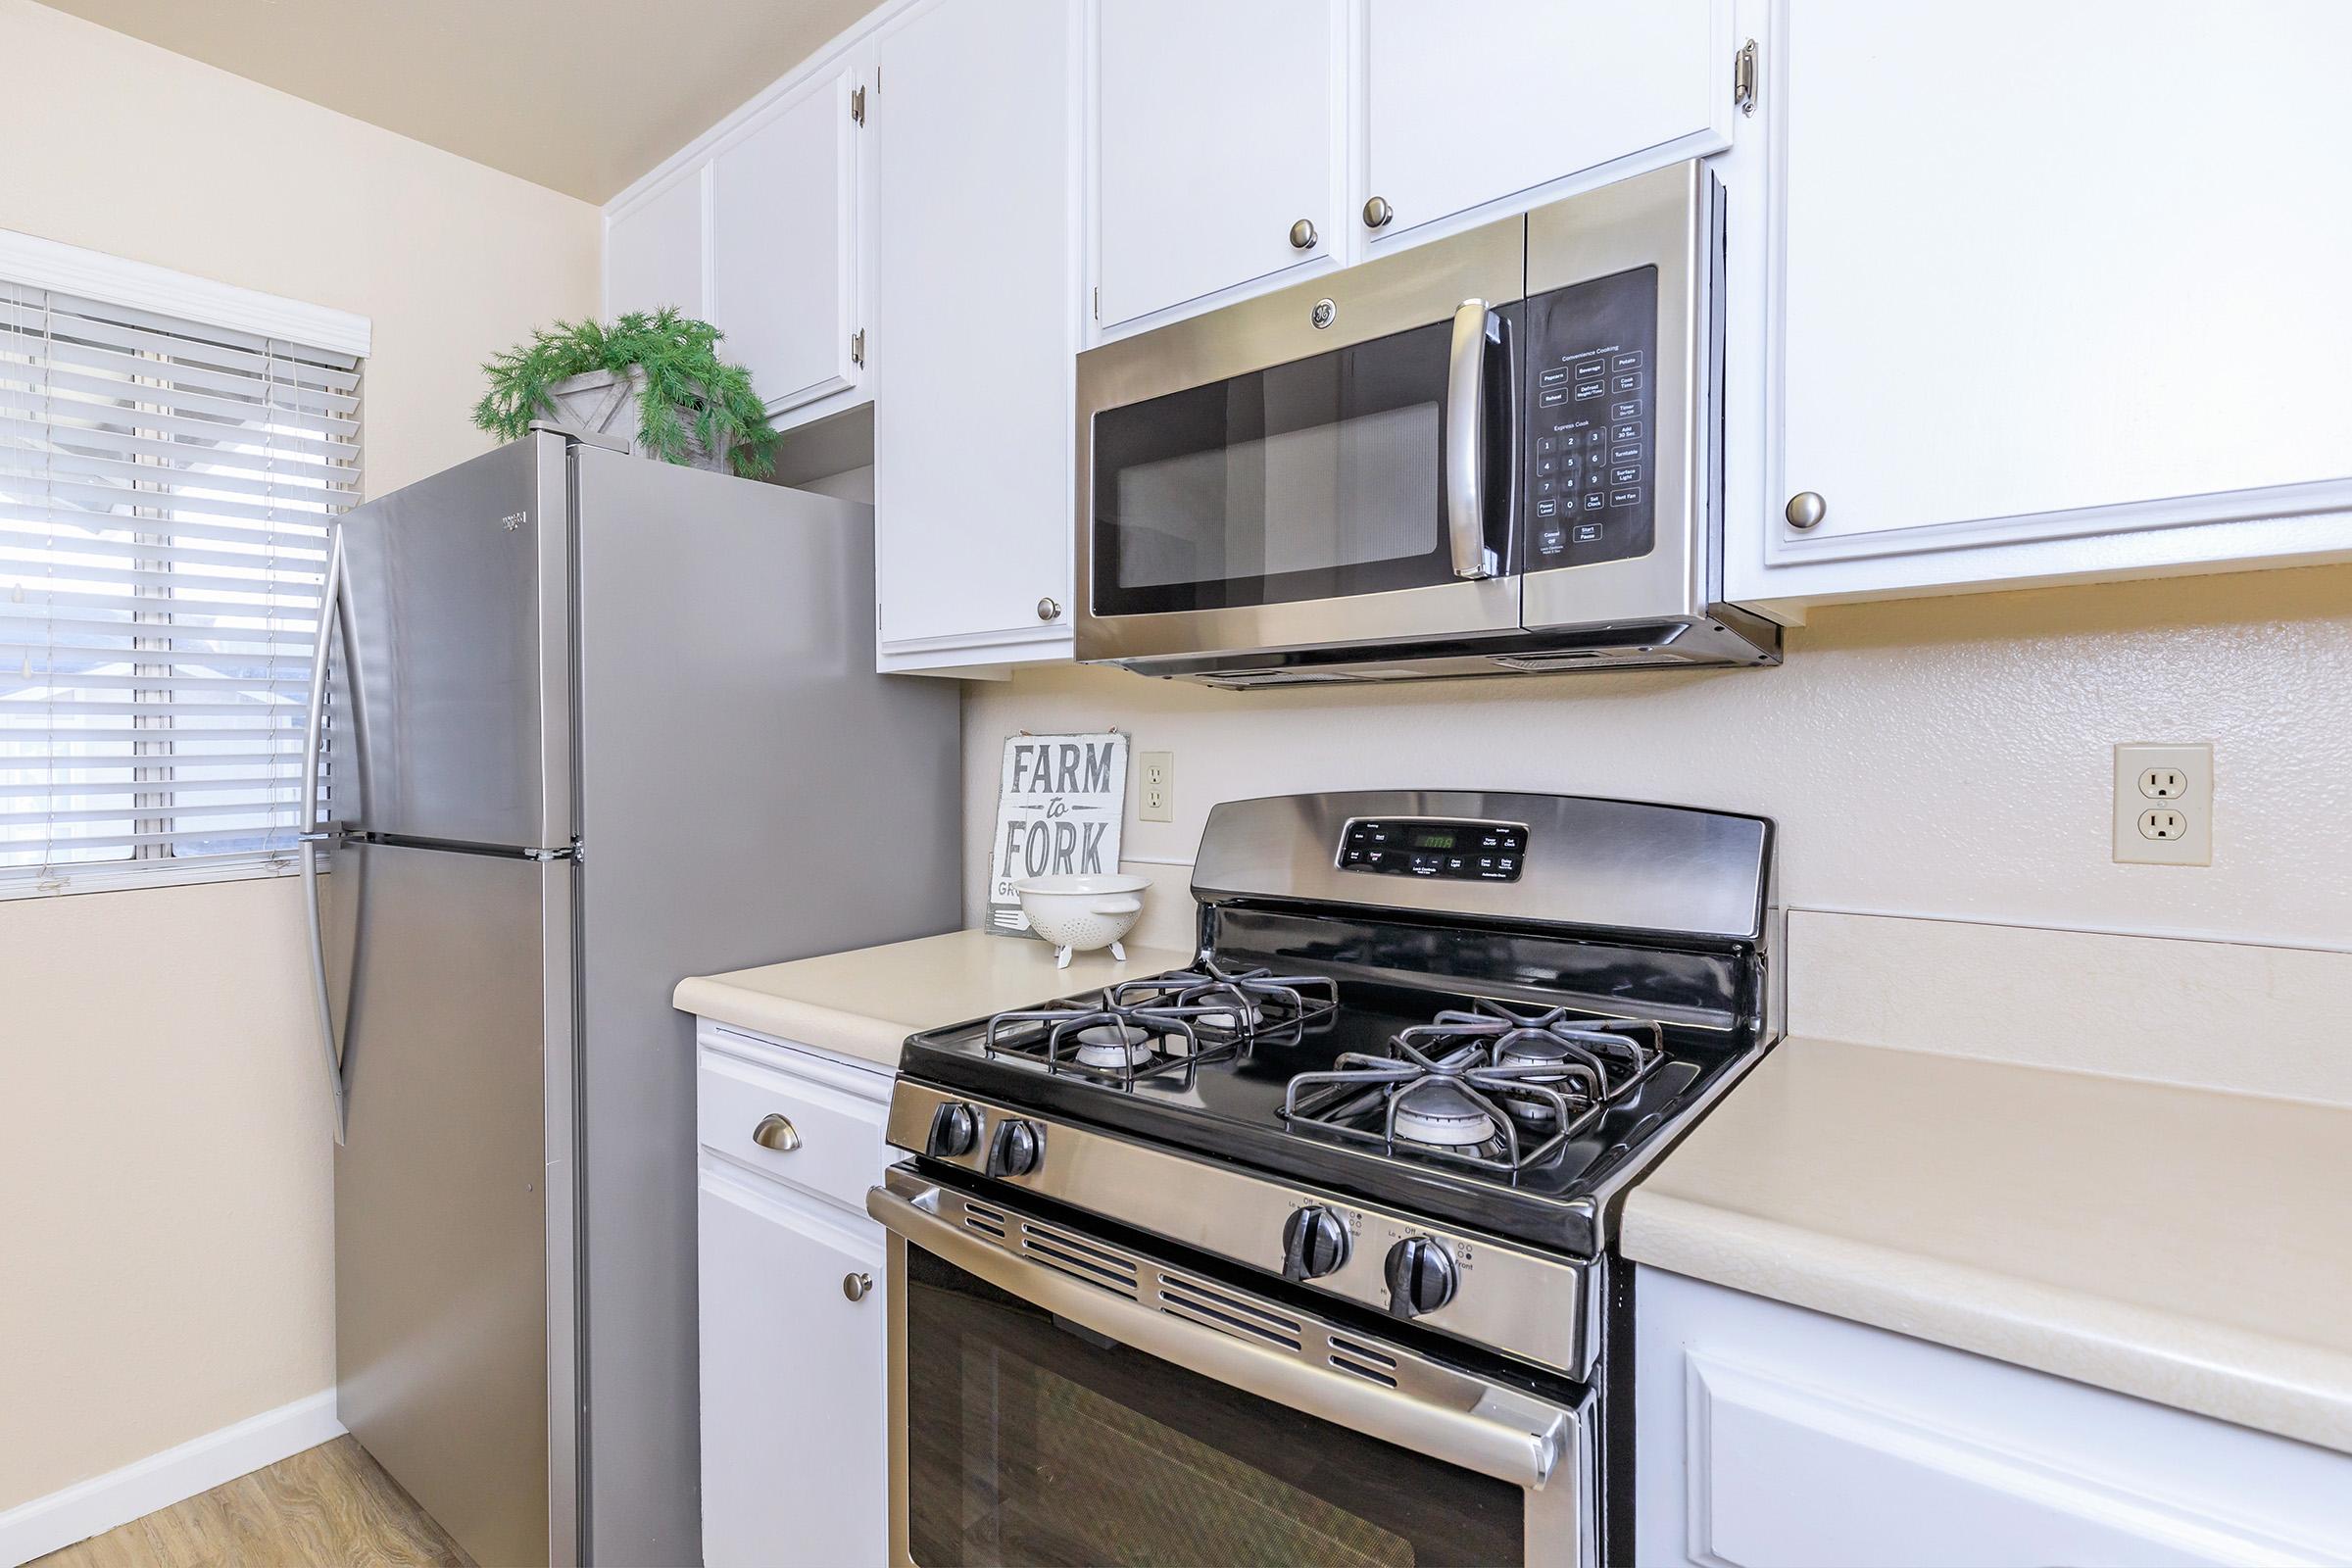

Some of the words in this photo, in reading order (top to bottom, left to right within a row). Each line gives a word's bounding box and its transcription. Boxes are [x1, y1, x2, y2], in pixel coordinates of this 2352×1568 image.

[1562, 351, 1595, 363] Convenience
[1596, 344, 1620, 355] Cooking
[1579, 365, 1601, 374] Beverage
[1544, 372, 1564, 381] Popcorn
[1553, 422, 1575, 431] Express
[1010, 742, 1114, 794] FARM
[1047, 796, 1068, 818] to
[1002, 820, 1108, 878] FORK
[1303, 1197, 1313, 1205] Off
[1404, 1226, 1416, 1236] Off
[1454, 1258, 1473, 1271] Front
